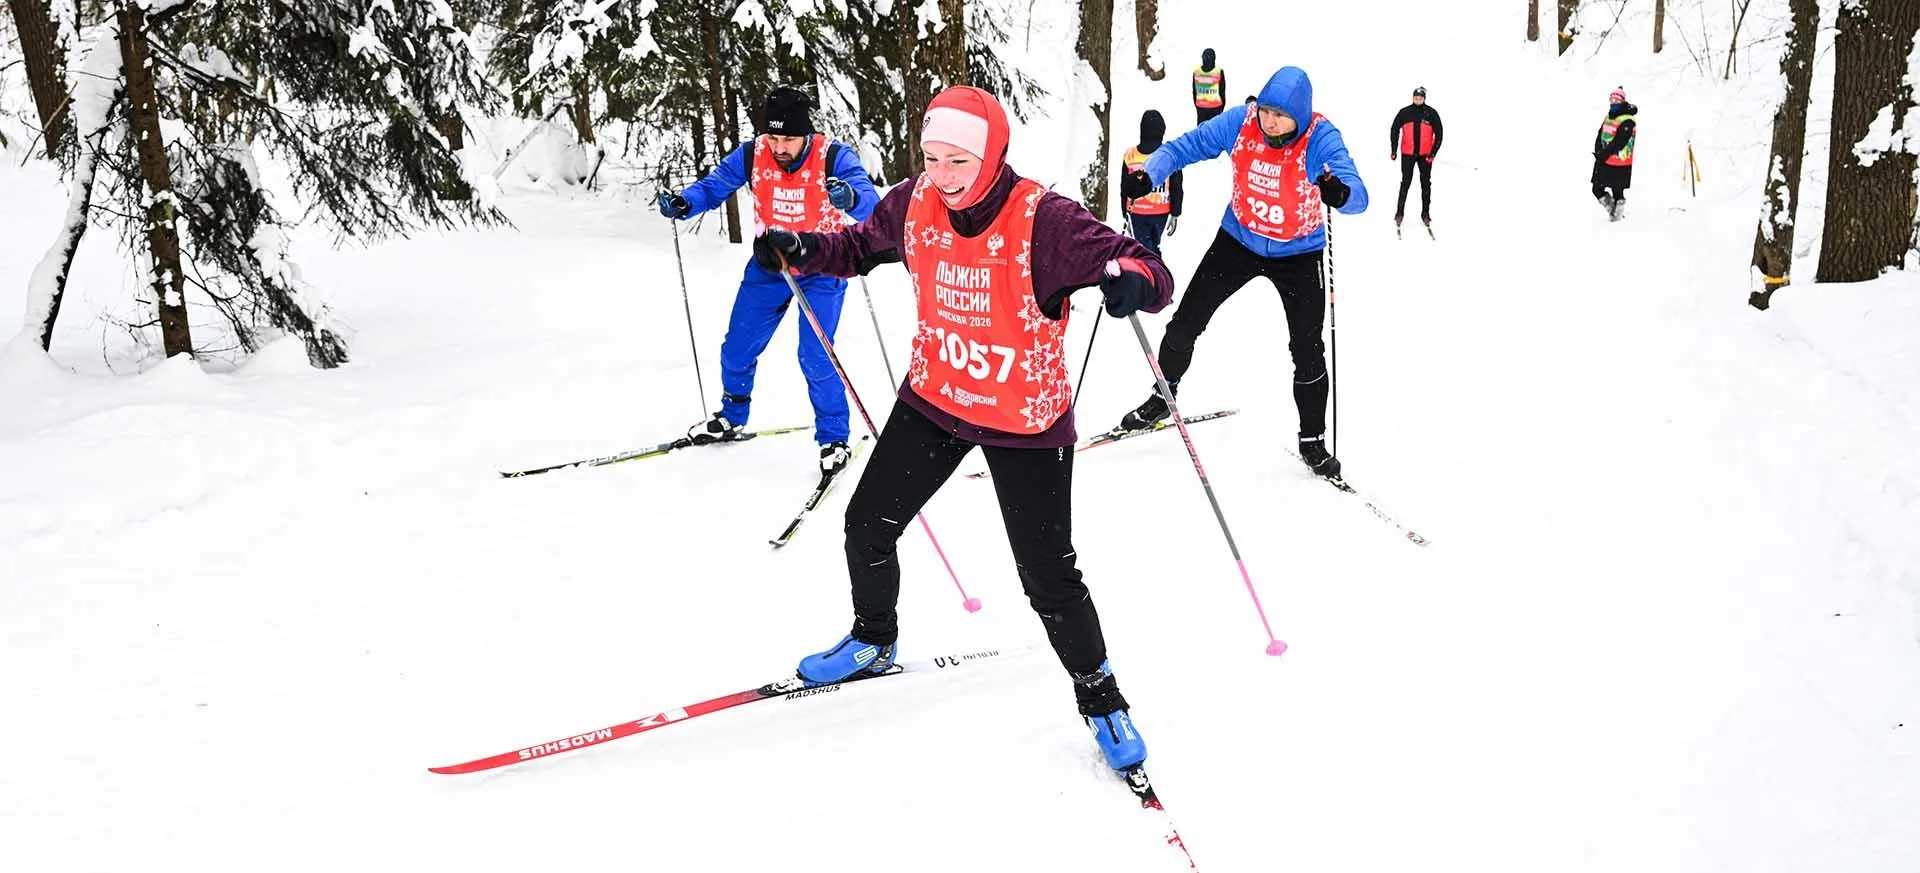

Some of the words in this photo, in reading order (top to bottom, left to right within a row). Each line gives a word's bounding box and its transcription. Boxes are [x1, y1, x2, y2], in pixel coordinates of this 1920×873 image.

[936, 260, 990, 289] ЛЫЖНЯ
[936, 284, 990, 313] РОССИИ
[969, 316, 992, 328] 2026
[936, 327, 1016, 384] 1057
[785, 684, 841, 701] MADSHUS
[519, 728, 613, 760] MADSHUS
